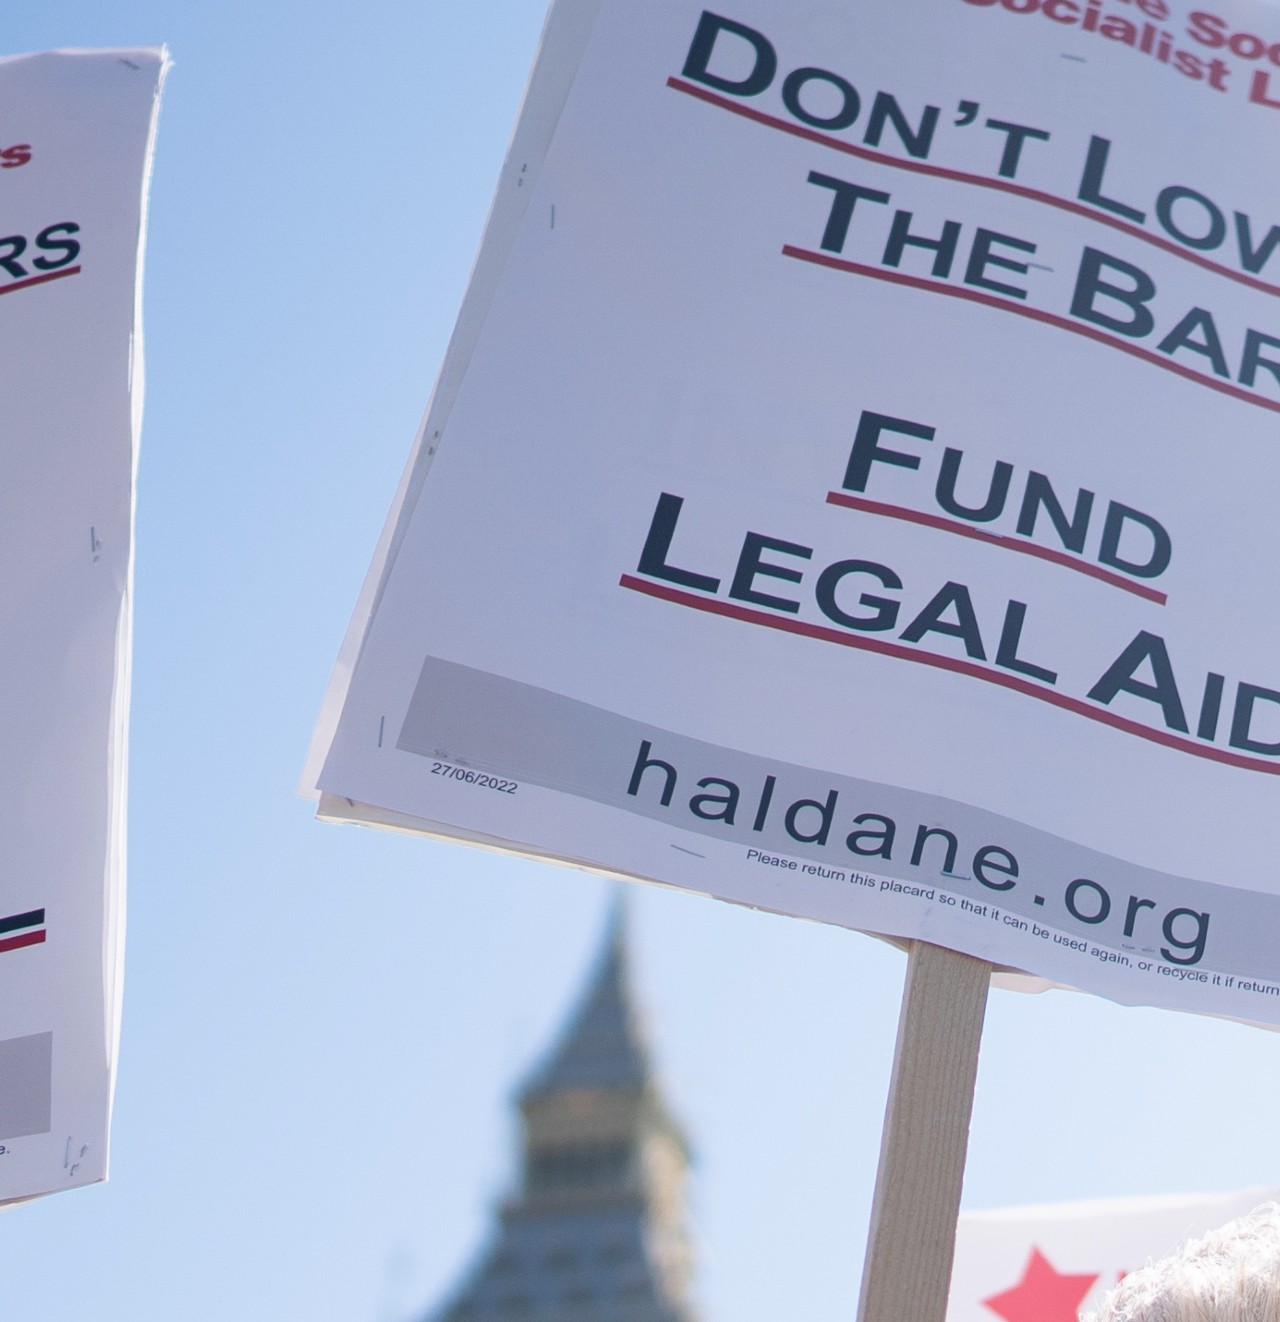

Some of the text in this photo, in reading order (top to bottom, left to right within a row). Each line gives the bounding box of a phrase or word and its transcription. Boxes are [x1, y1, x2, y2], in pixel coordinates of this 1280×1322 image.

[678, 9, 1050, 182] DON’T
[961, 0, 1229, 92] ocialist
[806, 170, 1038, 301] THE
[840, 408, 1174, 581] FUND
[635, 490, 1060, 686] LEGAL
[430, 762, 519, 795] 27/06/2022
[625, 739, 1214, 967] haldane.org
[746, 849, 798, 871] Please
[802, 863, 846, 882] return
[850, 872, 876, 888] this
[880, 878, 935, 901] placard
[938, 893, 956, 907] so
[960, 899, 988, 918] that
[991, 907, 1000, 921] it
[1003, 915, 1028, 932] can
[1032, 924, 1050, 940] be
[1053, 933, 1087, 953] used
[1090, 947, 1133, 969] again,
[1137, 959, 1153, 972] or
[1156, 963, 1209, 983] recycle
[1212, 974, 1221, 987] it
[1225, 976, 1235, 989] if
[1237, 978, 1280, 997] return
